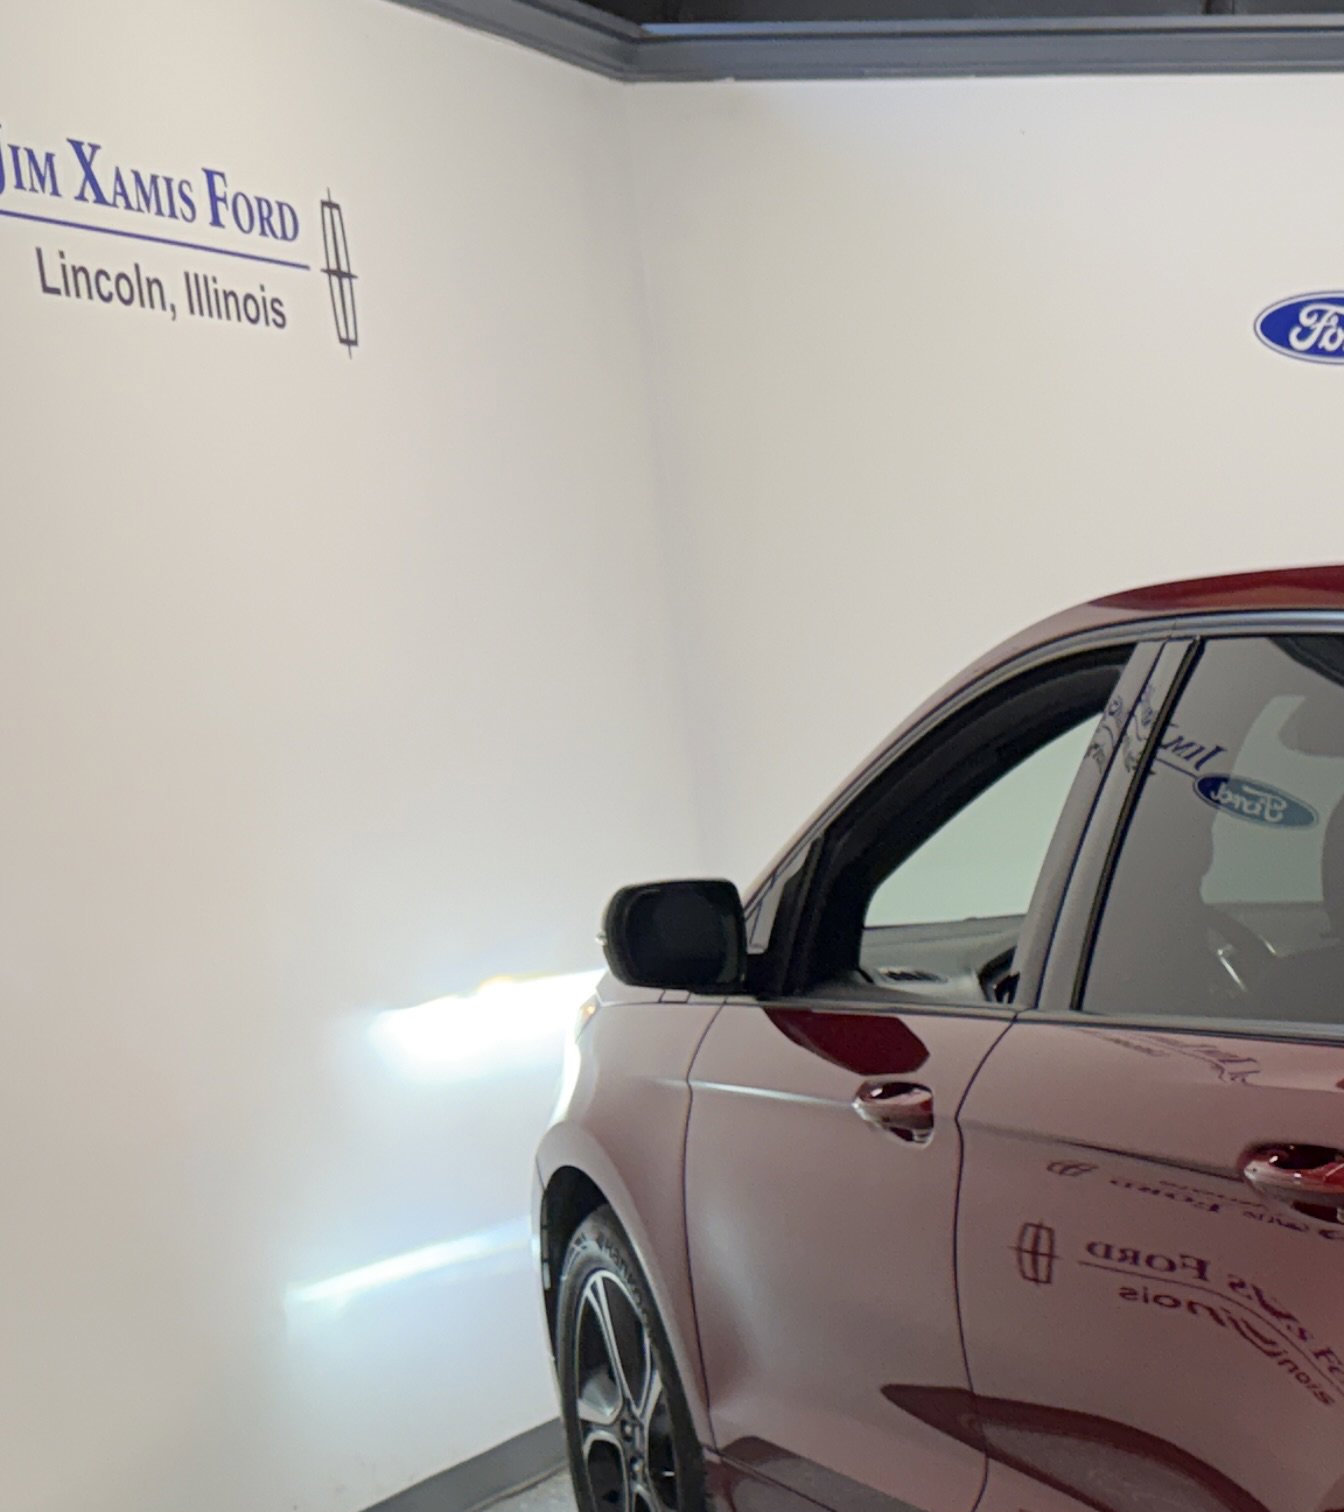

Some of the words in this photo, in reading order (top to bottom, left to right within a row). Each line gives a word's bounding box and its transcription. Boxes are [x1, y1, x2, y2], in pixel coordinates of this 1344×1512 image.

[0, 124, 62, 197] IM
[66, 137, 196, 224] XAMIS
[202, 166, 300, 243] FORD
[35, 246, 177, 322] Lincoln,
[184, 270, 288, 330] Illinois
